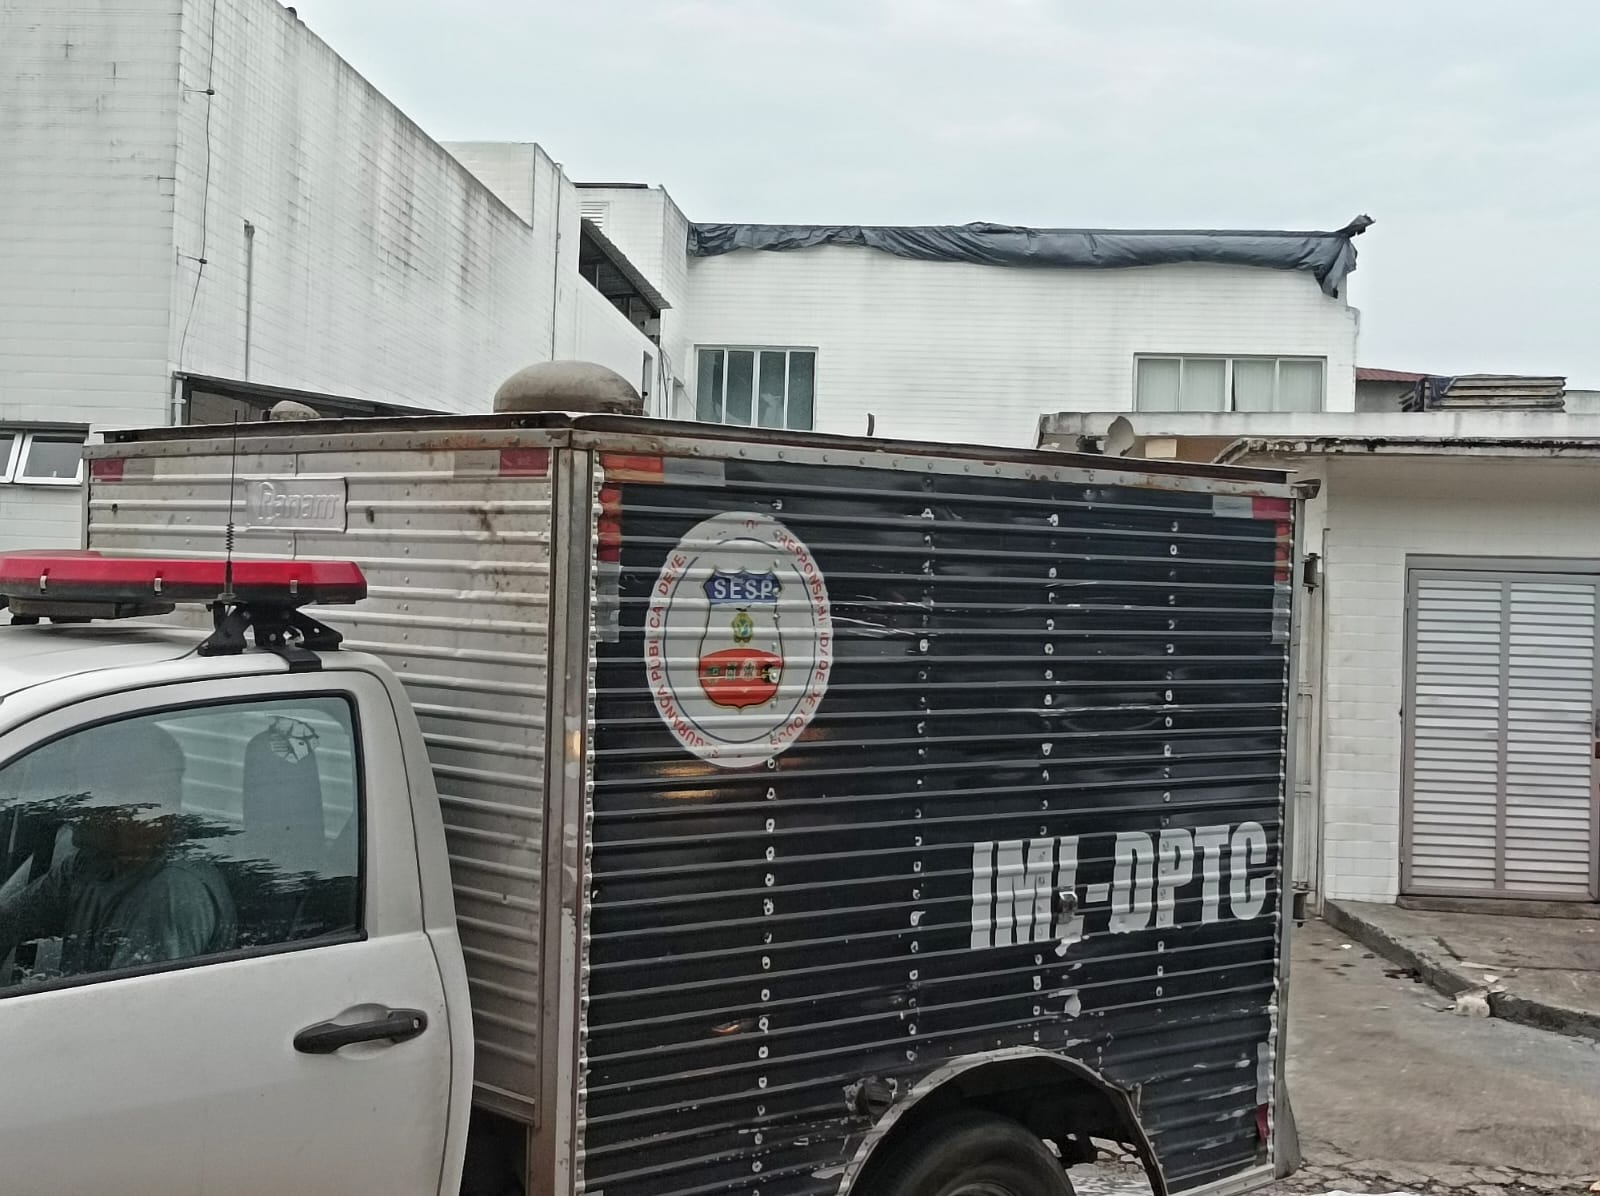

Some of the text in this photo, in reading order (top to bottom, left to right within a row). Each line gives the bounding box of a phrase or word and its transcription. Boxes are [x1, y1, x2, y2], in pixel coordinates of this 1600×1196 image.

[714, 577, 773, 599] SESP
[657, 684, 720, 758] SGURANÇA
[971, 821, 1267, 949] IML-DPTC
